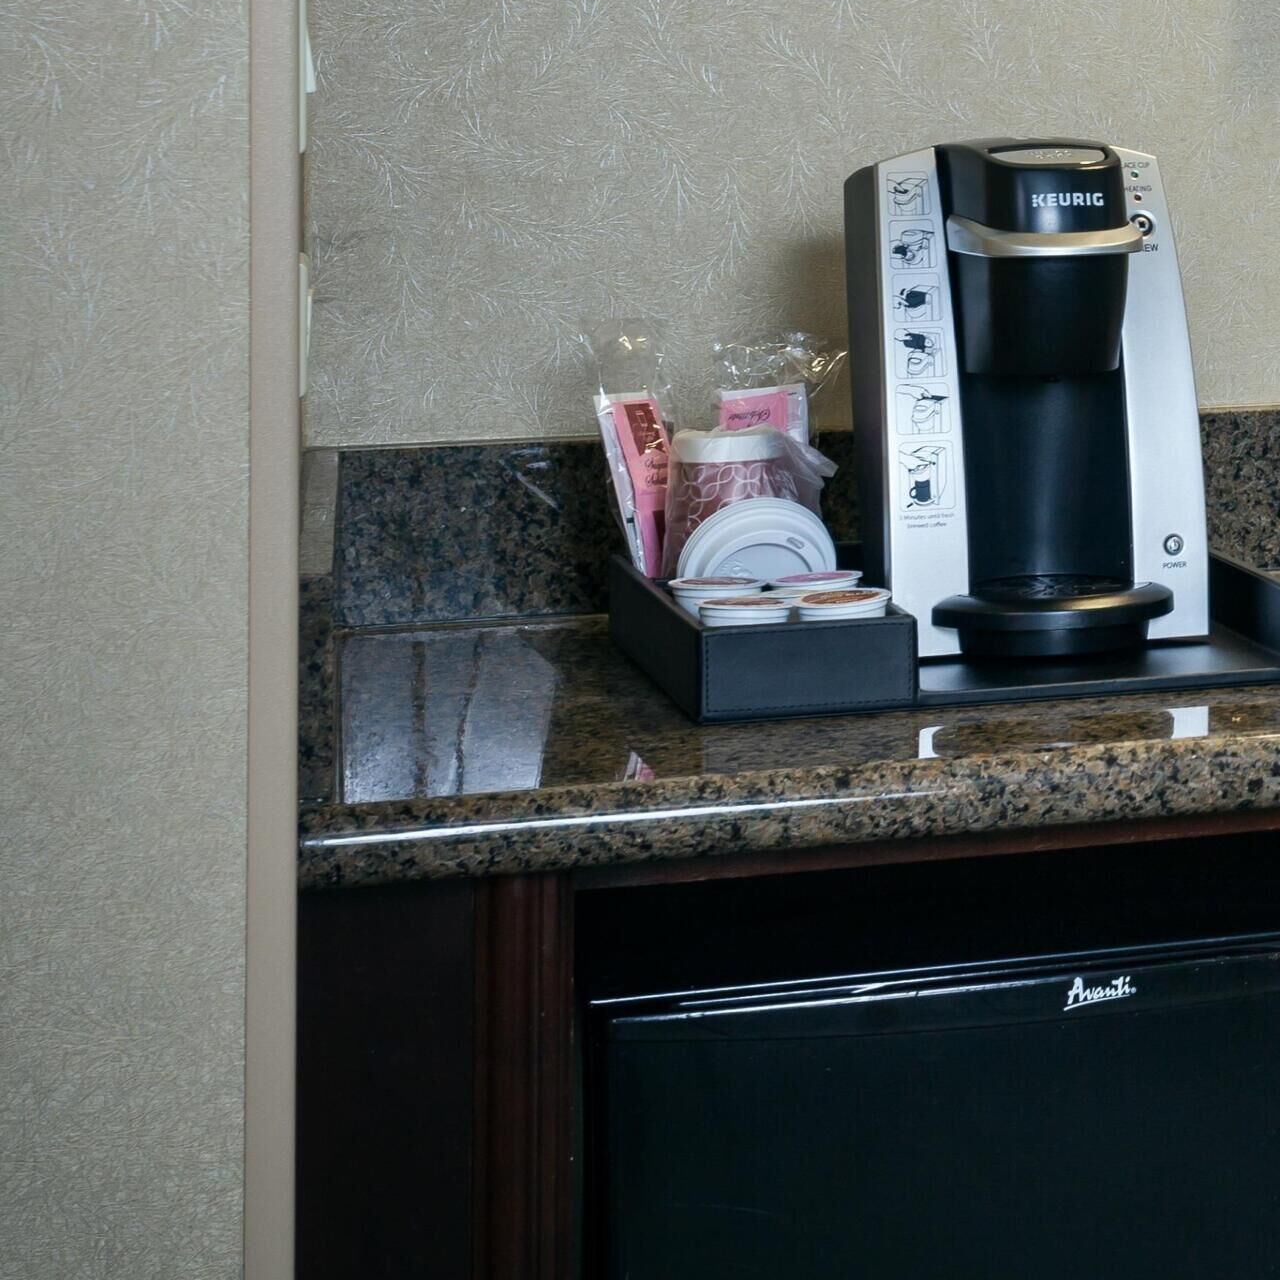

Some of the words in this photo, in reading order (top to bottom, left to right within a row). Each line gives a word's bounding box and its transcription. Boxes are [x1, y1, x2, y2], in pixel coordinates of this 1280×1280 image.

[1031, 192, 1105, 208] KEURIG
[1162, 561, 1188, 569] POWER
[1066, 975, 1132, 1007] Avanti
